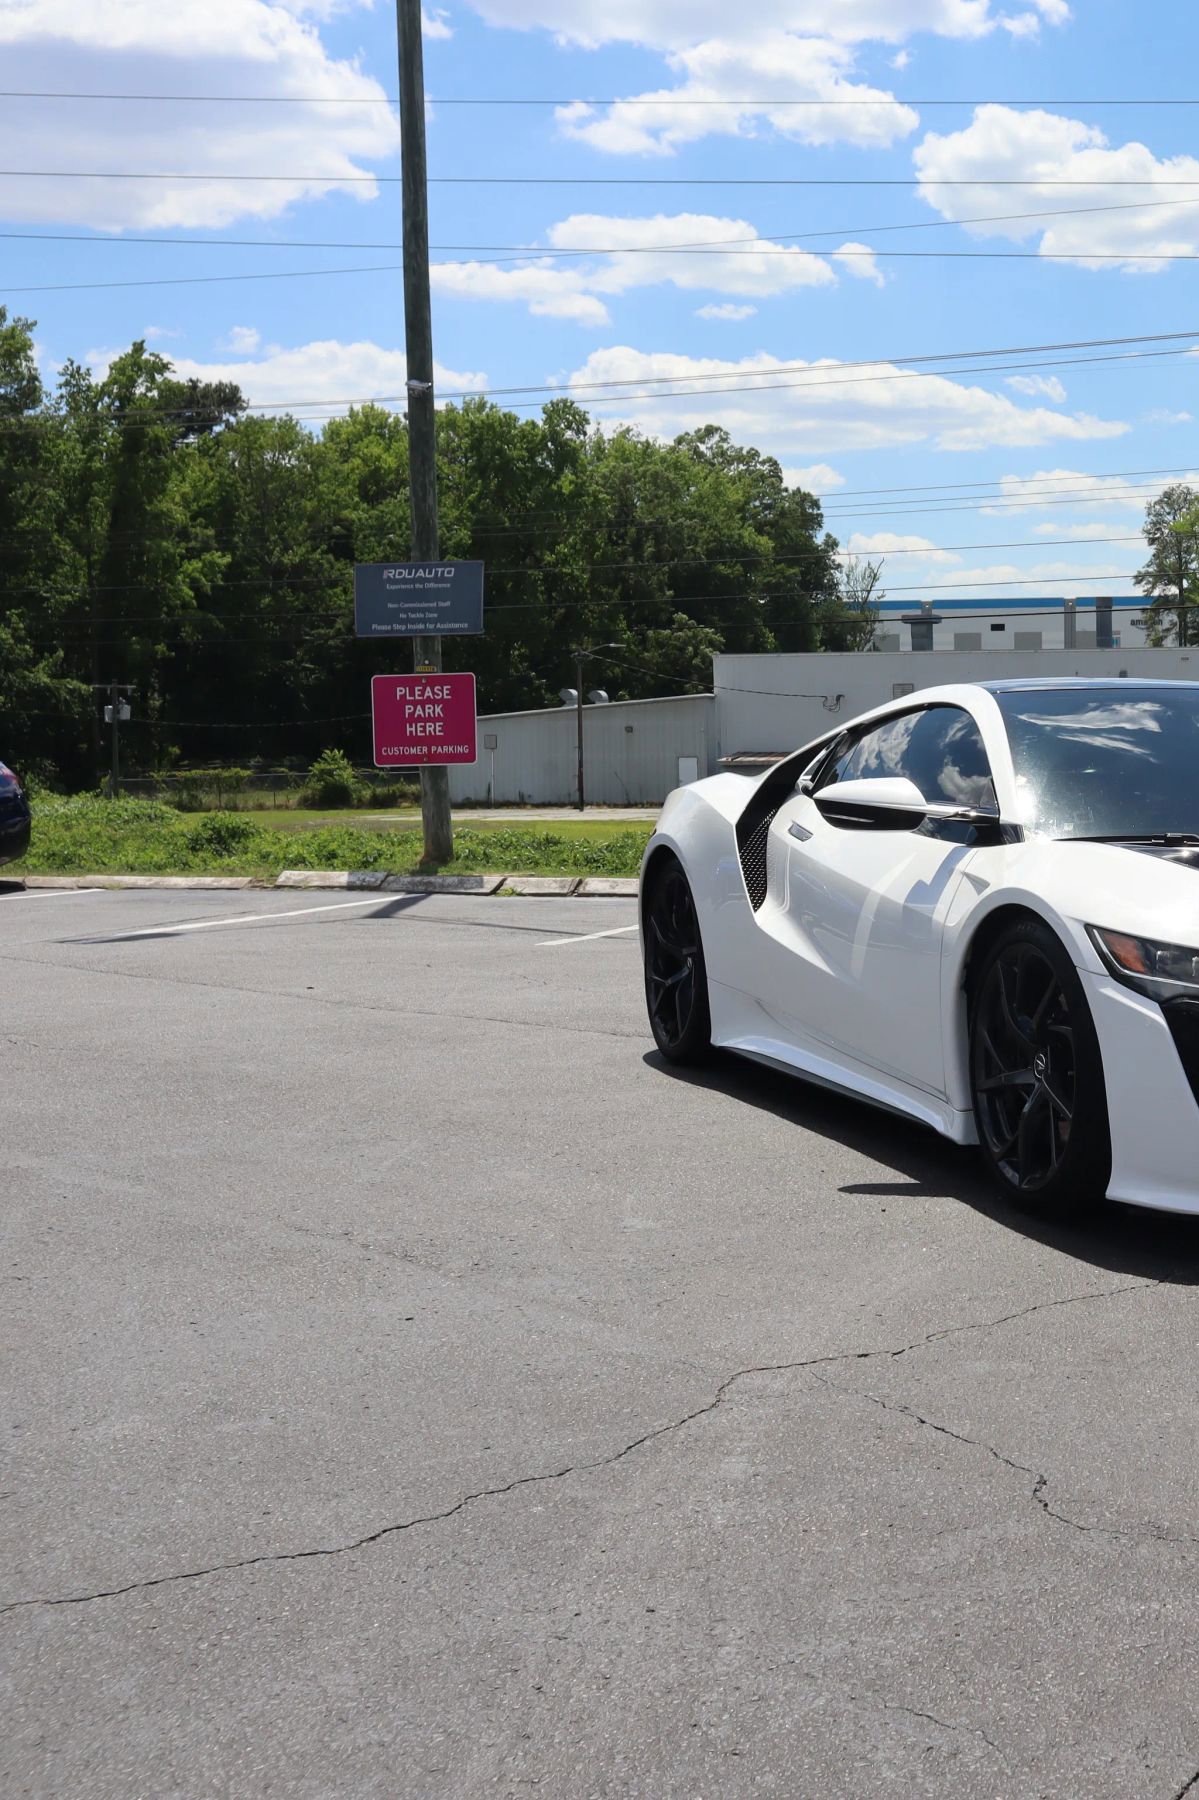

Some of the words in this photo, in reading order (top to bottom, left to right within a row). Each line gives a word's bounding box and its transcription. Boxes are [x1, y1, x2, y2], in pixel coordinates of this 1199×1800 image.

[396, 686, 452, 700] PLEASE
[405, 704, 444, 718] PARK
[406, 722, 444, 736] HERE
[382, 746, 428, 755] CUSTOMER
[431, 745, 469, 754] PARKING
